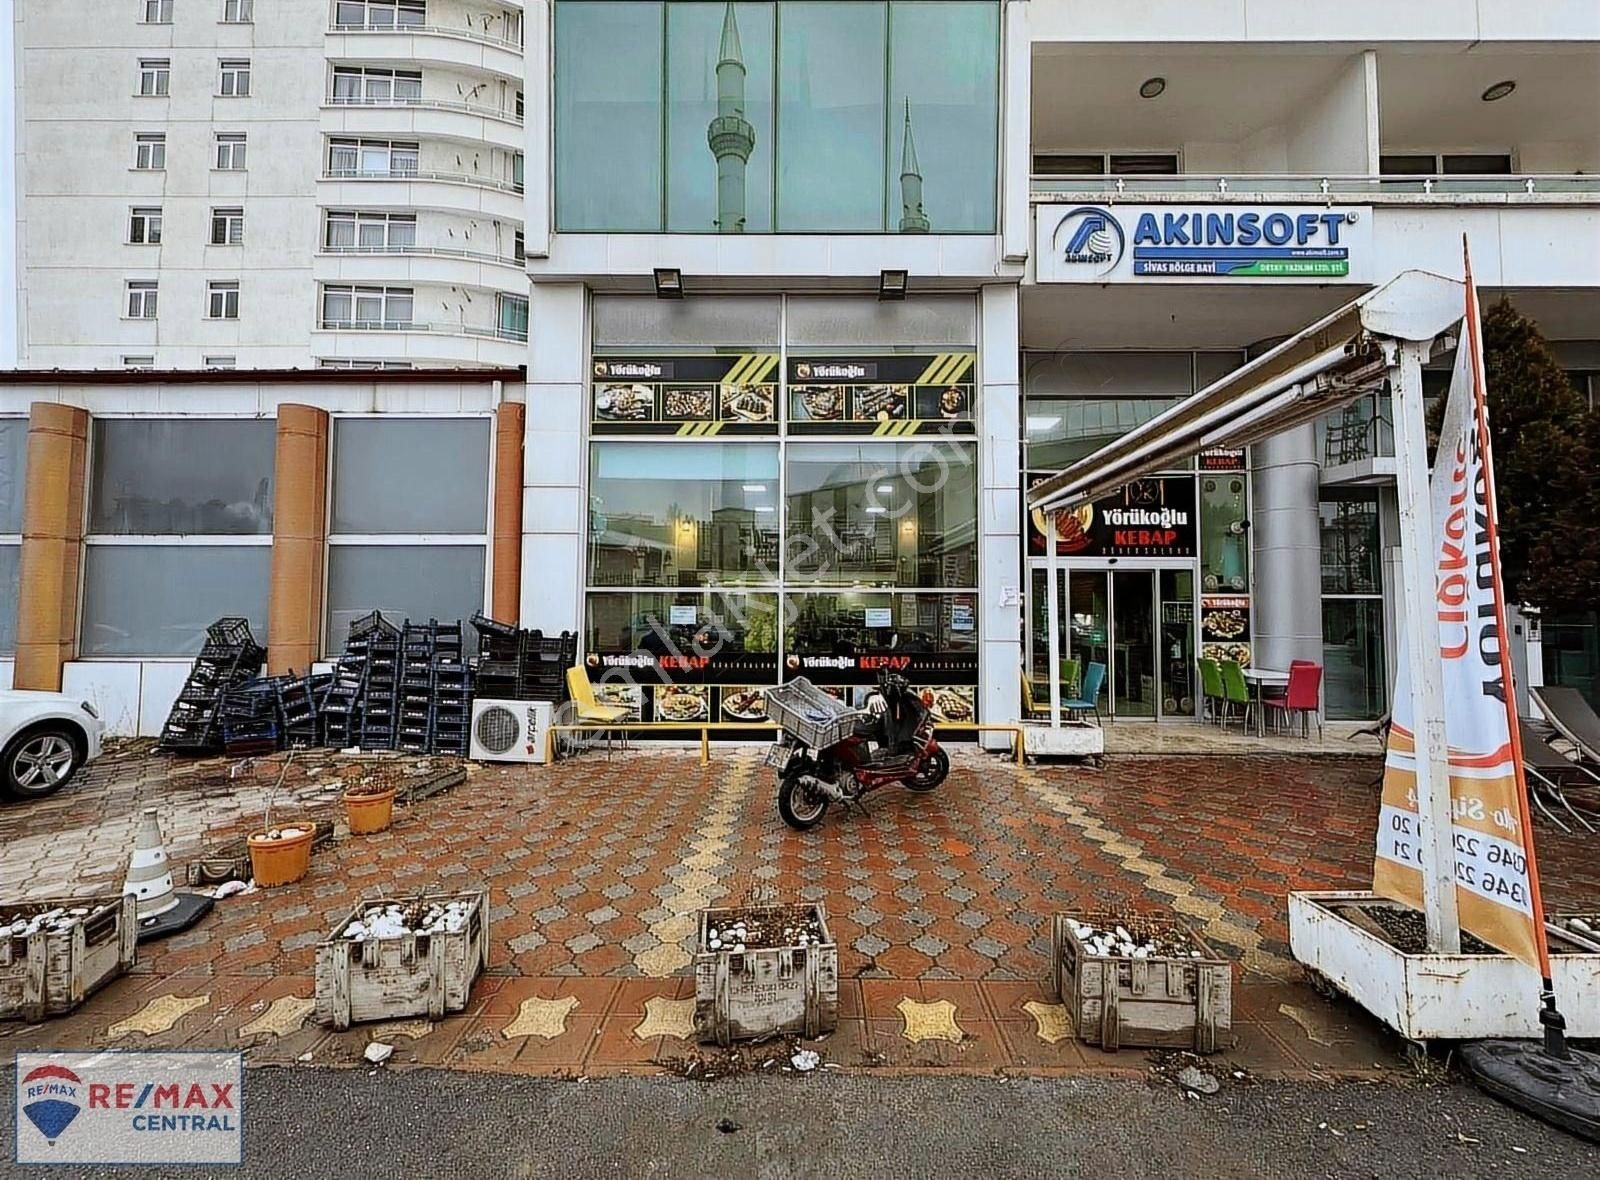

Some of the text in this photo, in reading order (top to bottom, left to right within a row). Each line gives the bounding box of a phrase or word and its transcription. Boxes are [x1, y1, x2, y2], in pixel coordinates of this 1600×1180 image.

[1134, 212, 1346, 246] AKINSOFT
[610, 363, 662, 378] Yörükoğlu
[813, 364, 865, 379] Yörükoğlu
[1102, 507, 1188, 529] Yörükoğlu
[1114, 530, 1177, 545] KEBAP
[603, 655, 655, 670] Yörükoğlu
[659, 655, 710, 669] KEBAP
[803, 656, 855, 669] Yörükoğlu
